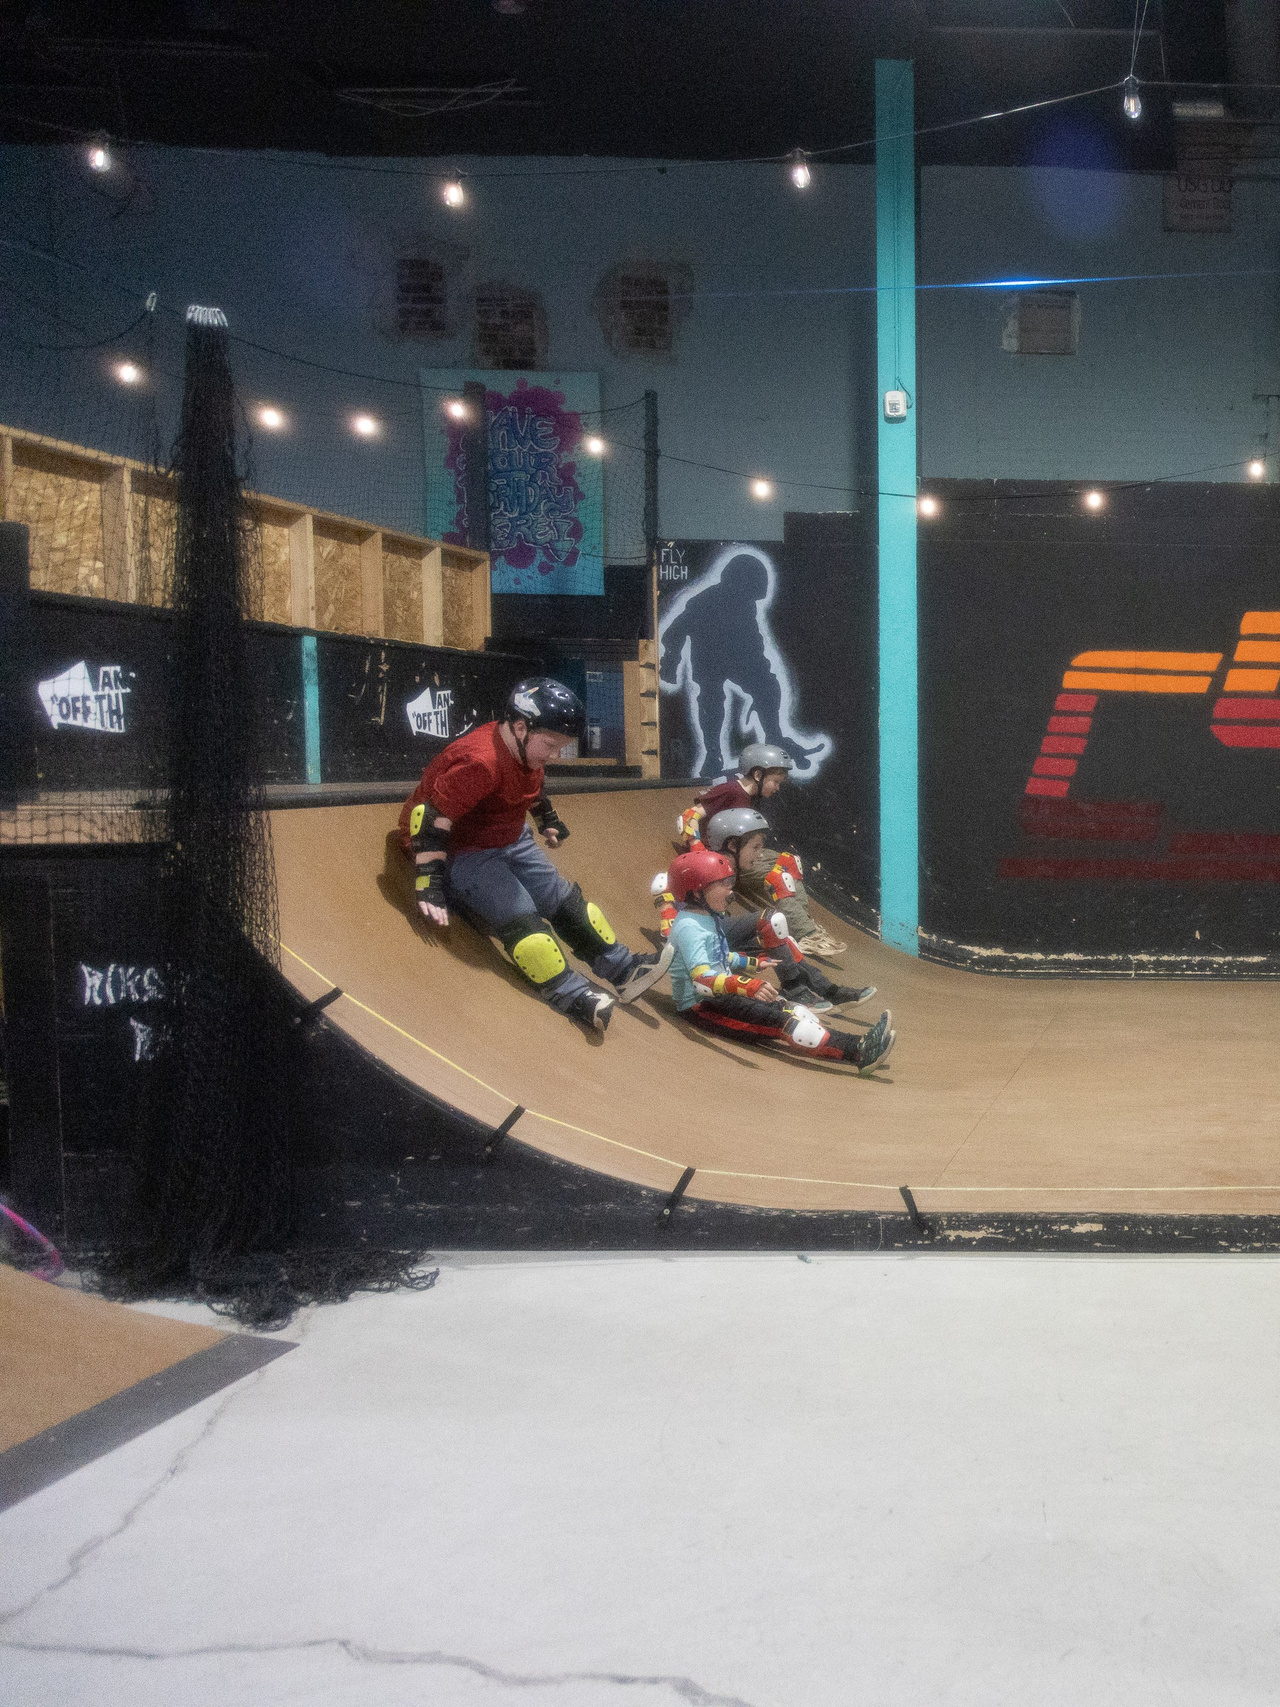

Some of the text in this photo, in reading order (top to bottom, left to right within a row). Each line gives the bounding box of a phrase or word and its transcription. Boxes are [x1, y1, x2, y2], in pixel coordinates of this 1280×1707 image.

[487, 405, 560, 452] AVE
[661, 548, 686, 564] FLY
[659, 565, 688, 580] HIGH
